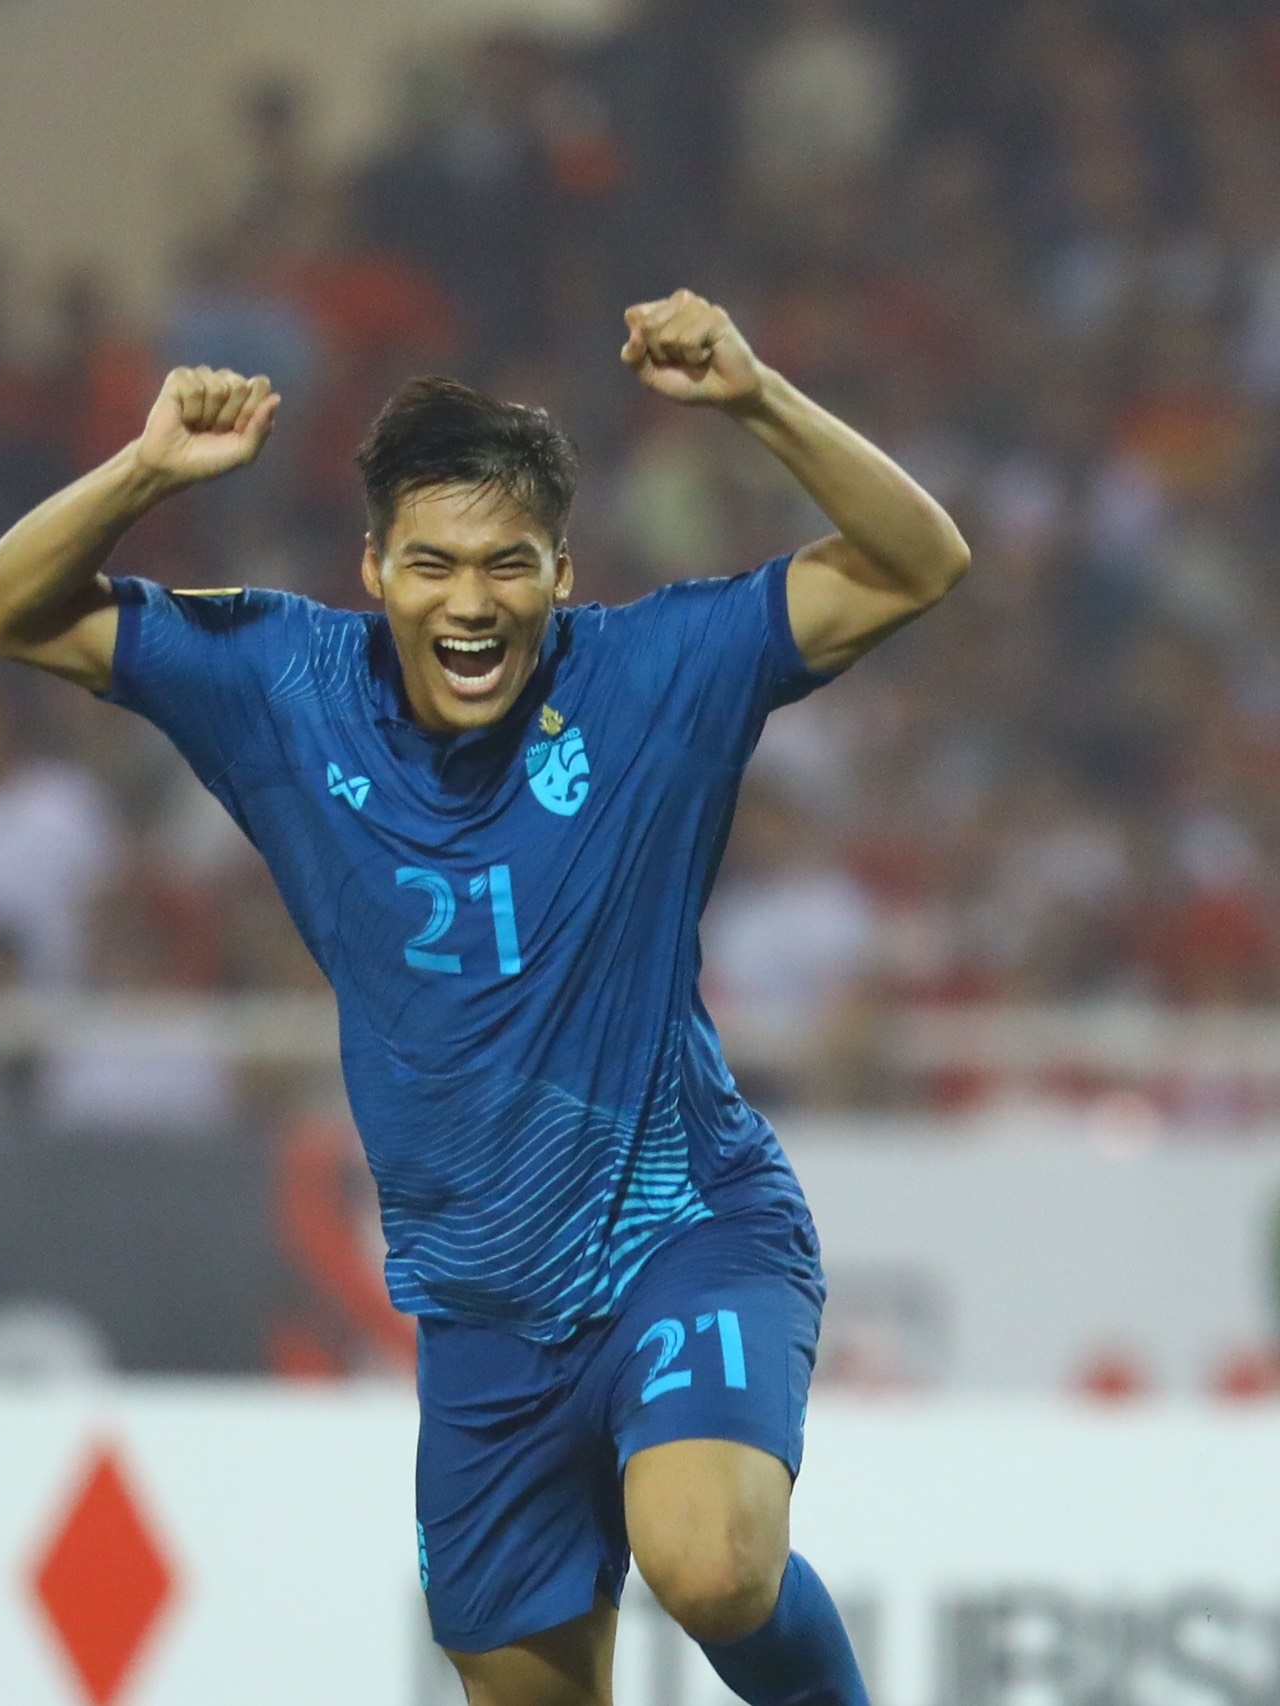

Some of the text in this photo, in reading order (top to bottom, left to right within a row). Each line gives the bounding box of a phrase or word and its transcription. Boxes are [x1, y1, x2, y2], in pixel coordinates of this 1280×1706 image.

[527, 727, 581, 757] THAAND
[395, 864, 522, 974] 21
[636, 1309, 747, 1405] 21
